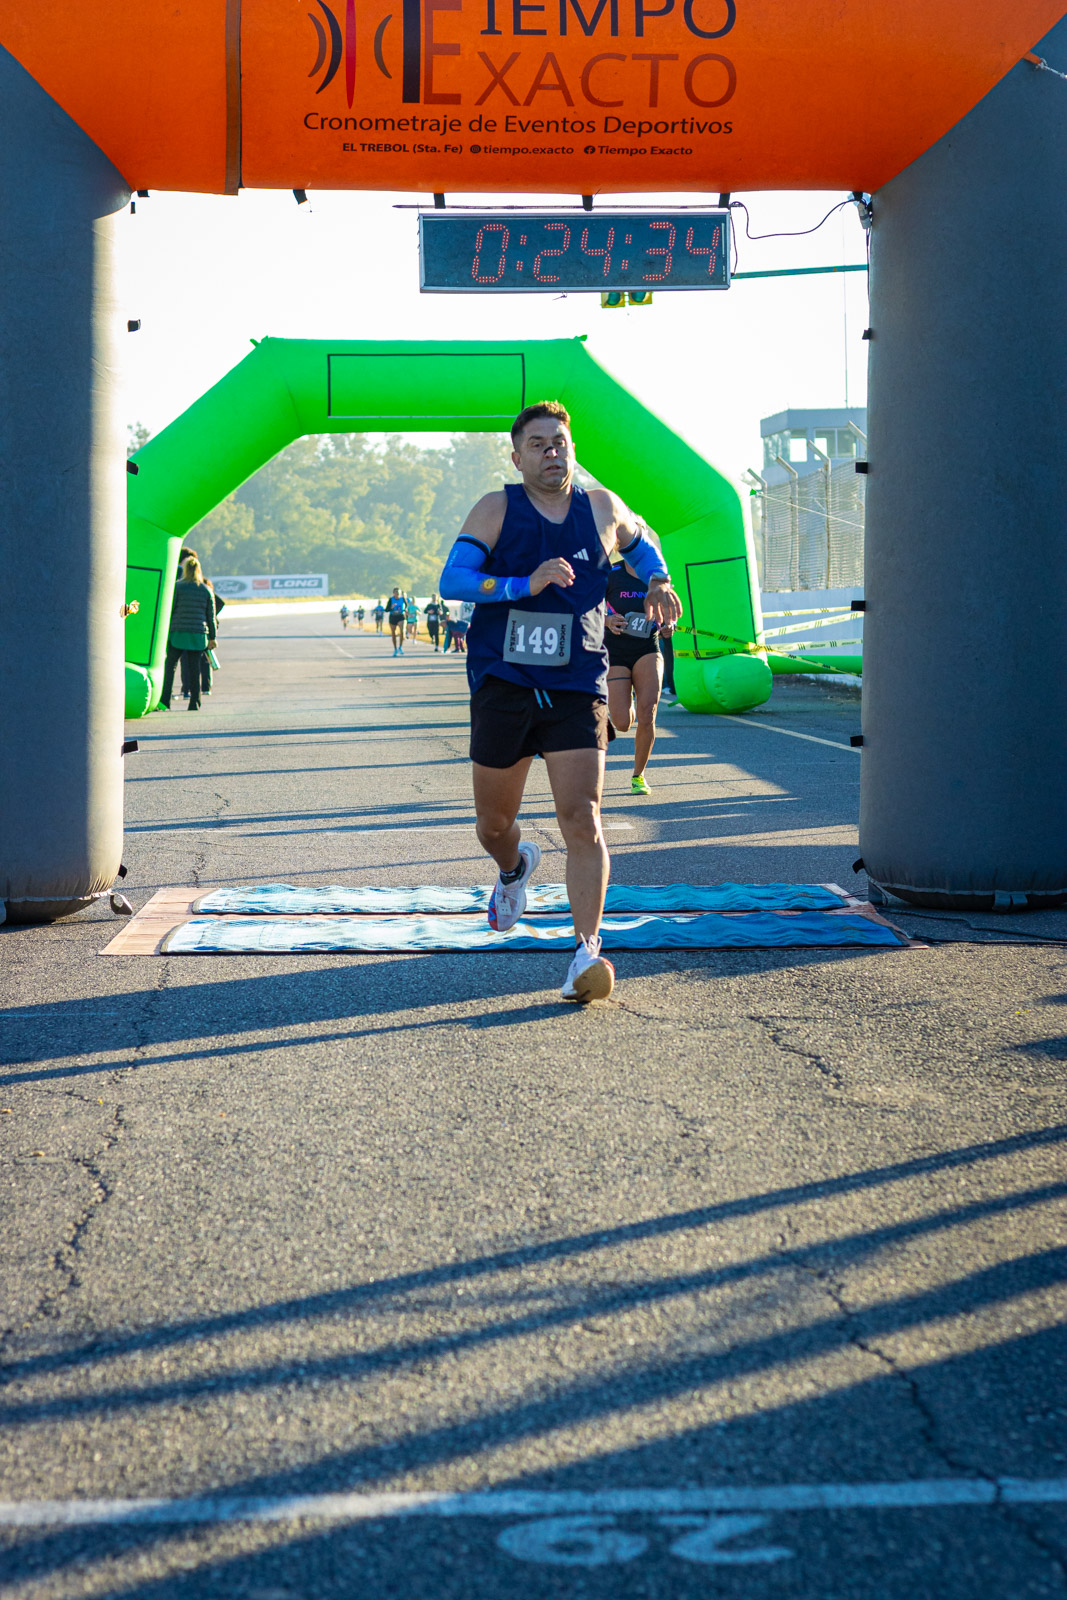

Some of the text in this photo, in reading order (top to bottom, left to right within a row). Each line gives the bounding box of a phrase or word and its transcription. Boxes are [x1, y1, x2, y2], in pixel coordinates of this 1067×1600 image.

[304, 113, 733, 137] Cronometraje de Eventos Deportivos
[343, 143, 693, 156] EL TREBOL (Sta. Fe) tiempo.exacto Tiempo Exacto
[472, 221, 719, 283] 0:24:34
[274, 579, 319, 587] LONG
[631, 617, 645, 631] 47
[516, 625, 558, 655] 149
